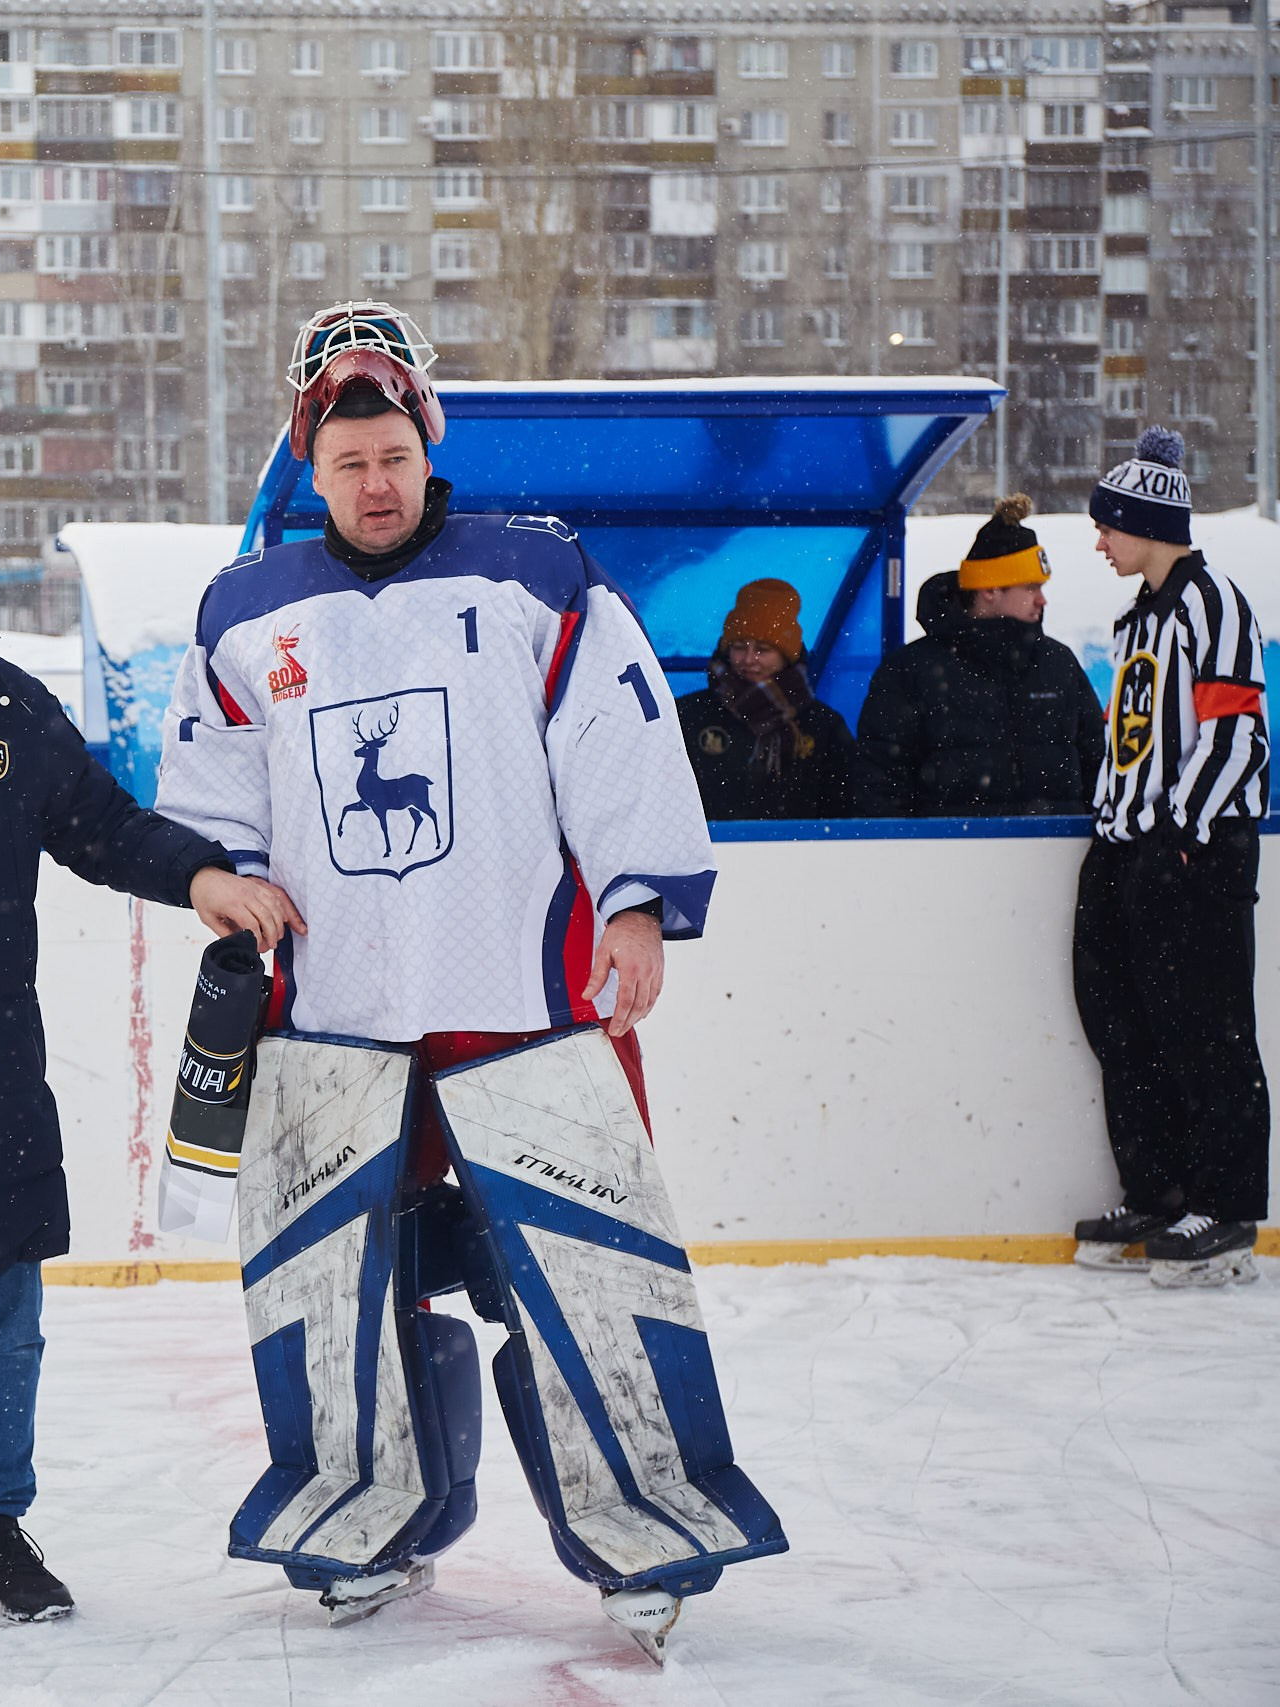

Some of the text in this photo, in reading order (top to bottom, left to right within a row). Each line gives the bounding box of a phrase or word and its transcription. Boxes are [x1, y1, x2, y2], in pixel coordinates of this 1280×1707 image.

[457, 606, 478, 653] 1
[268, 667, 290, 691] 80
[618, 662, 660, 723] 1
